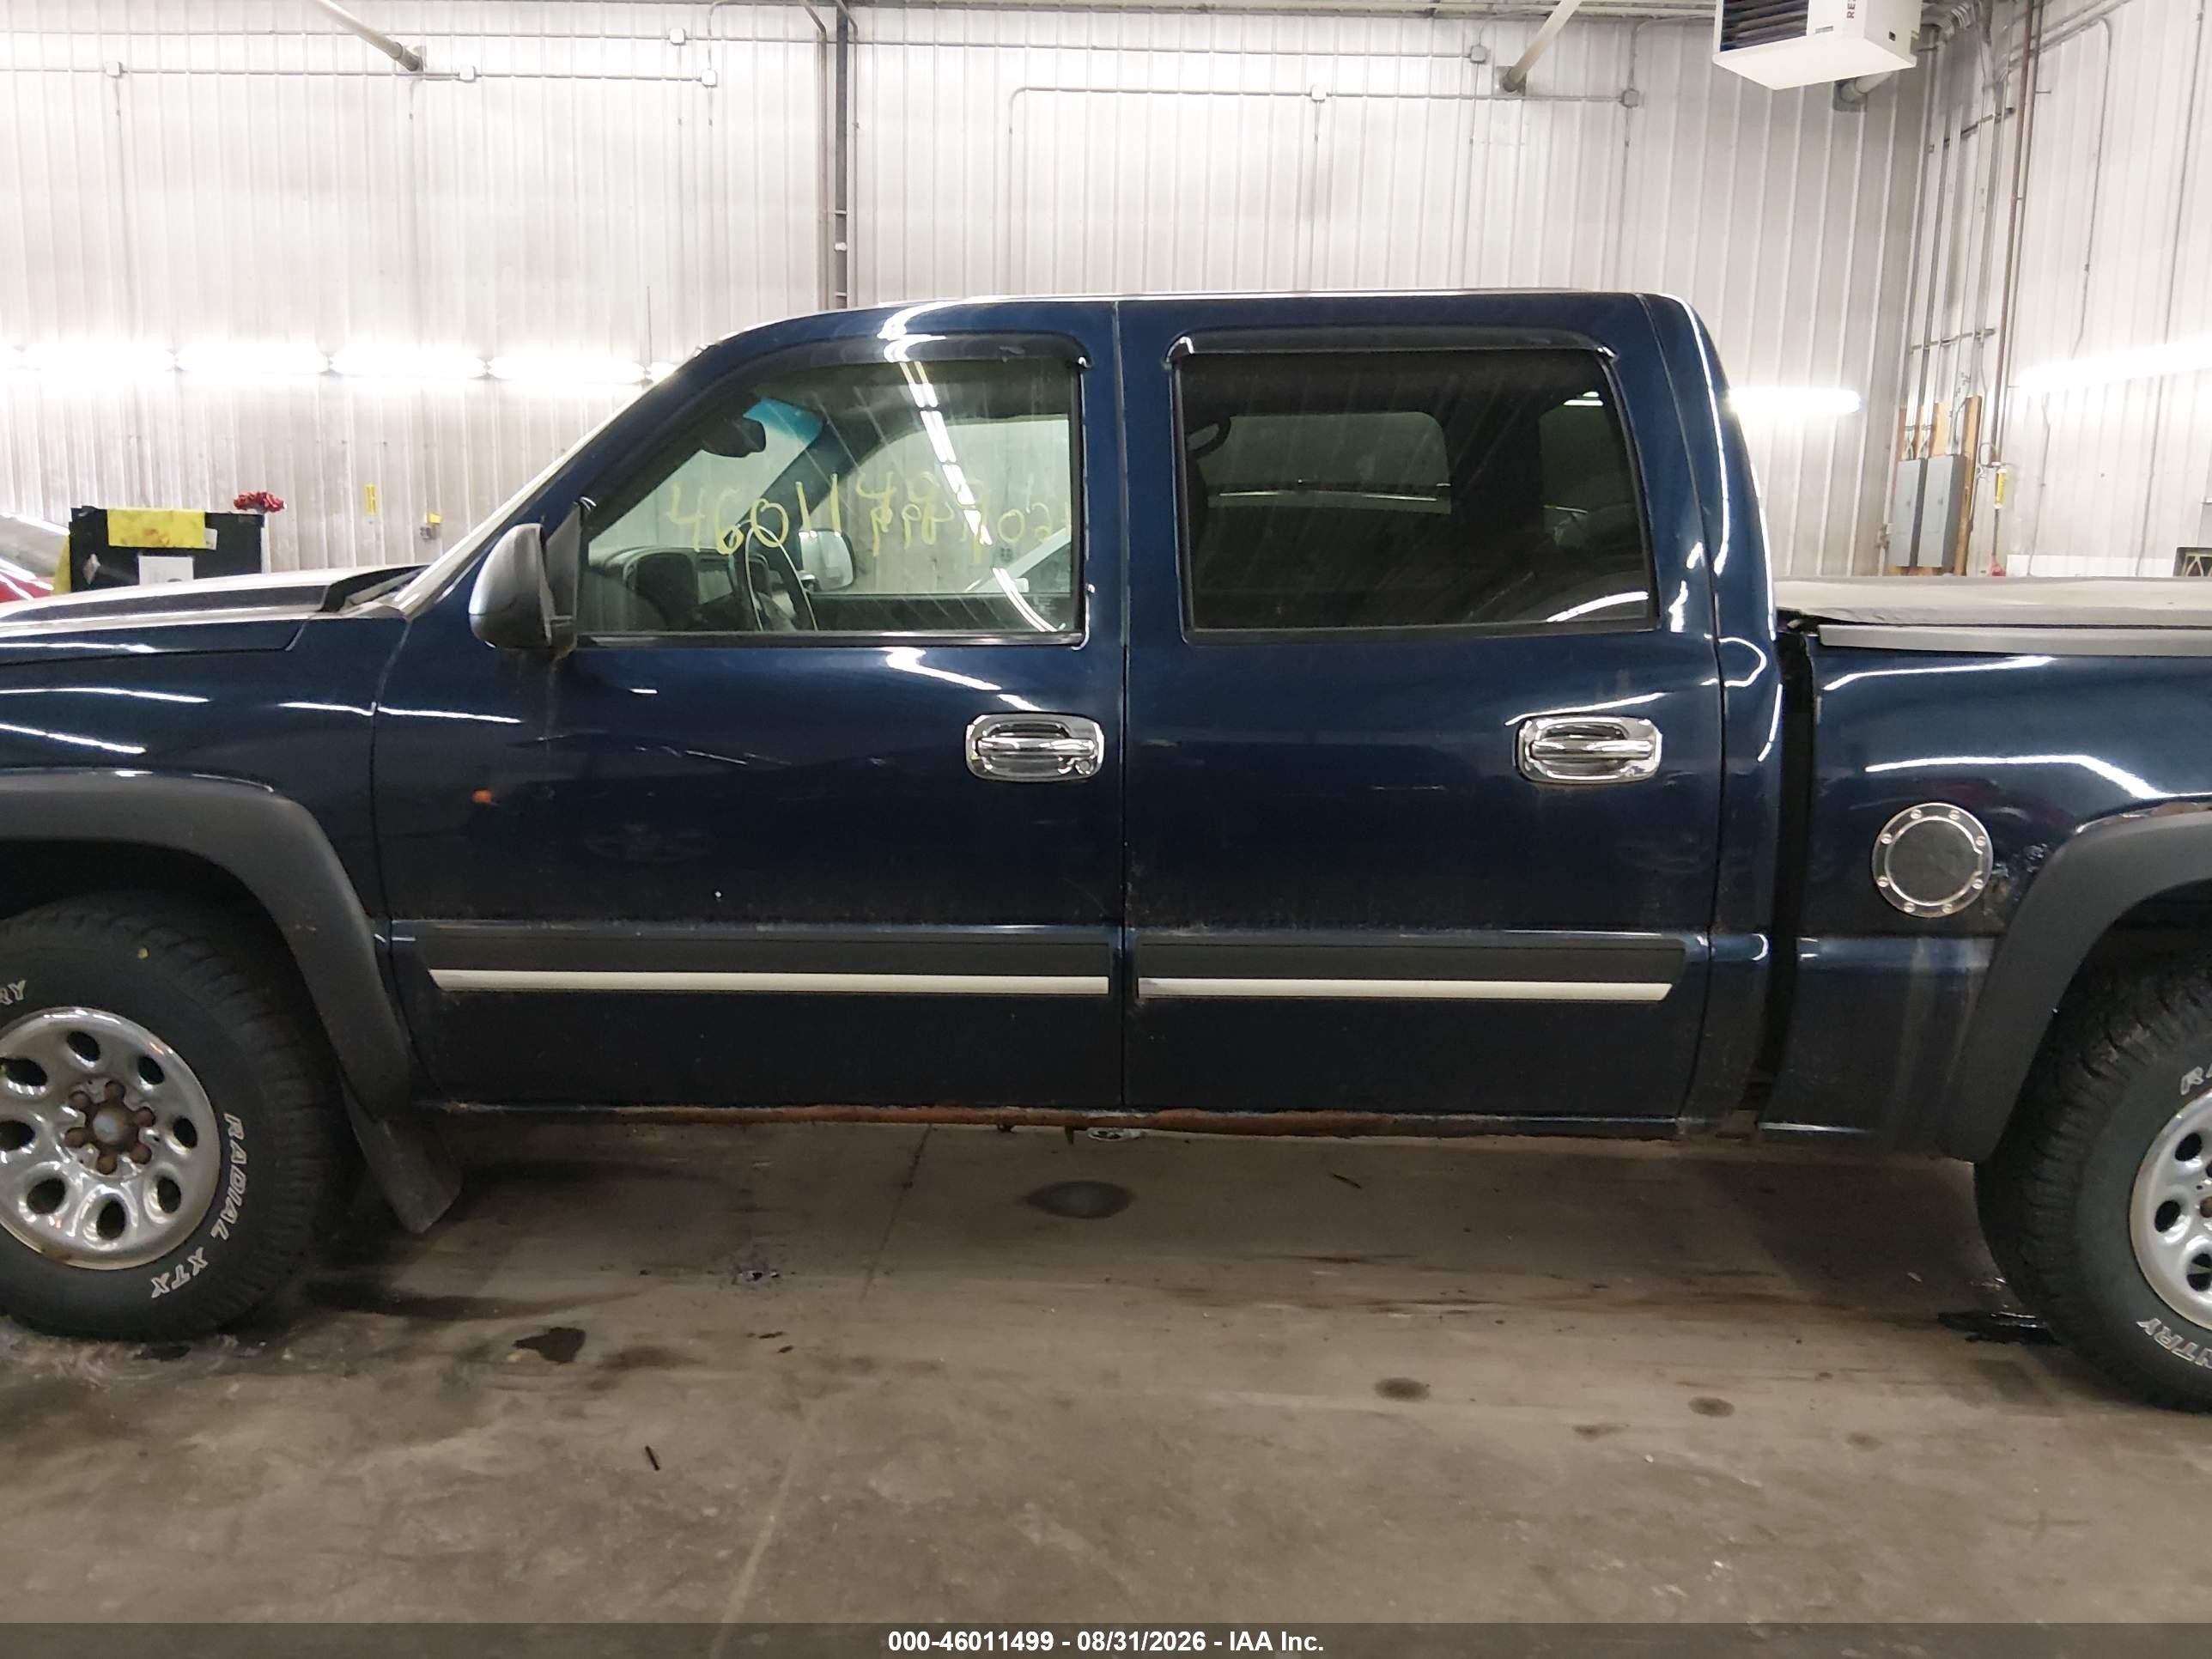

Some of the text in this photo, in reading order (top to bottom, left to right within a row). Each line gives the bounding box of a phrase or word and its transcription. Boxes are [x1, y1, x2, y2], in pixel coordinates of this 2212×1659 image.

[1846, 0, 1856, 19] RE
[151, 1113, 247, 1298] RADIAL XTX
